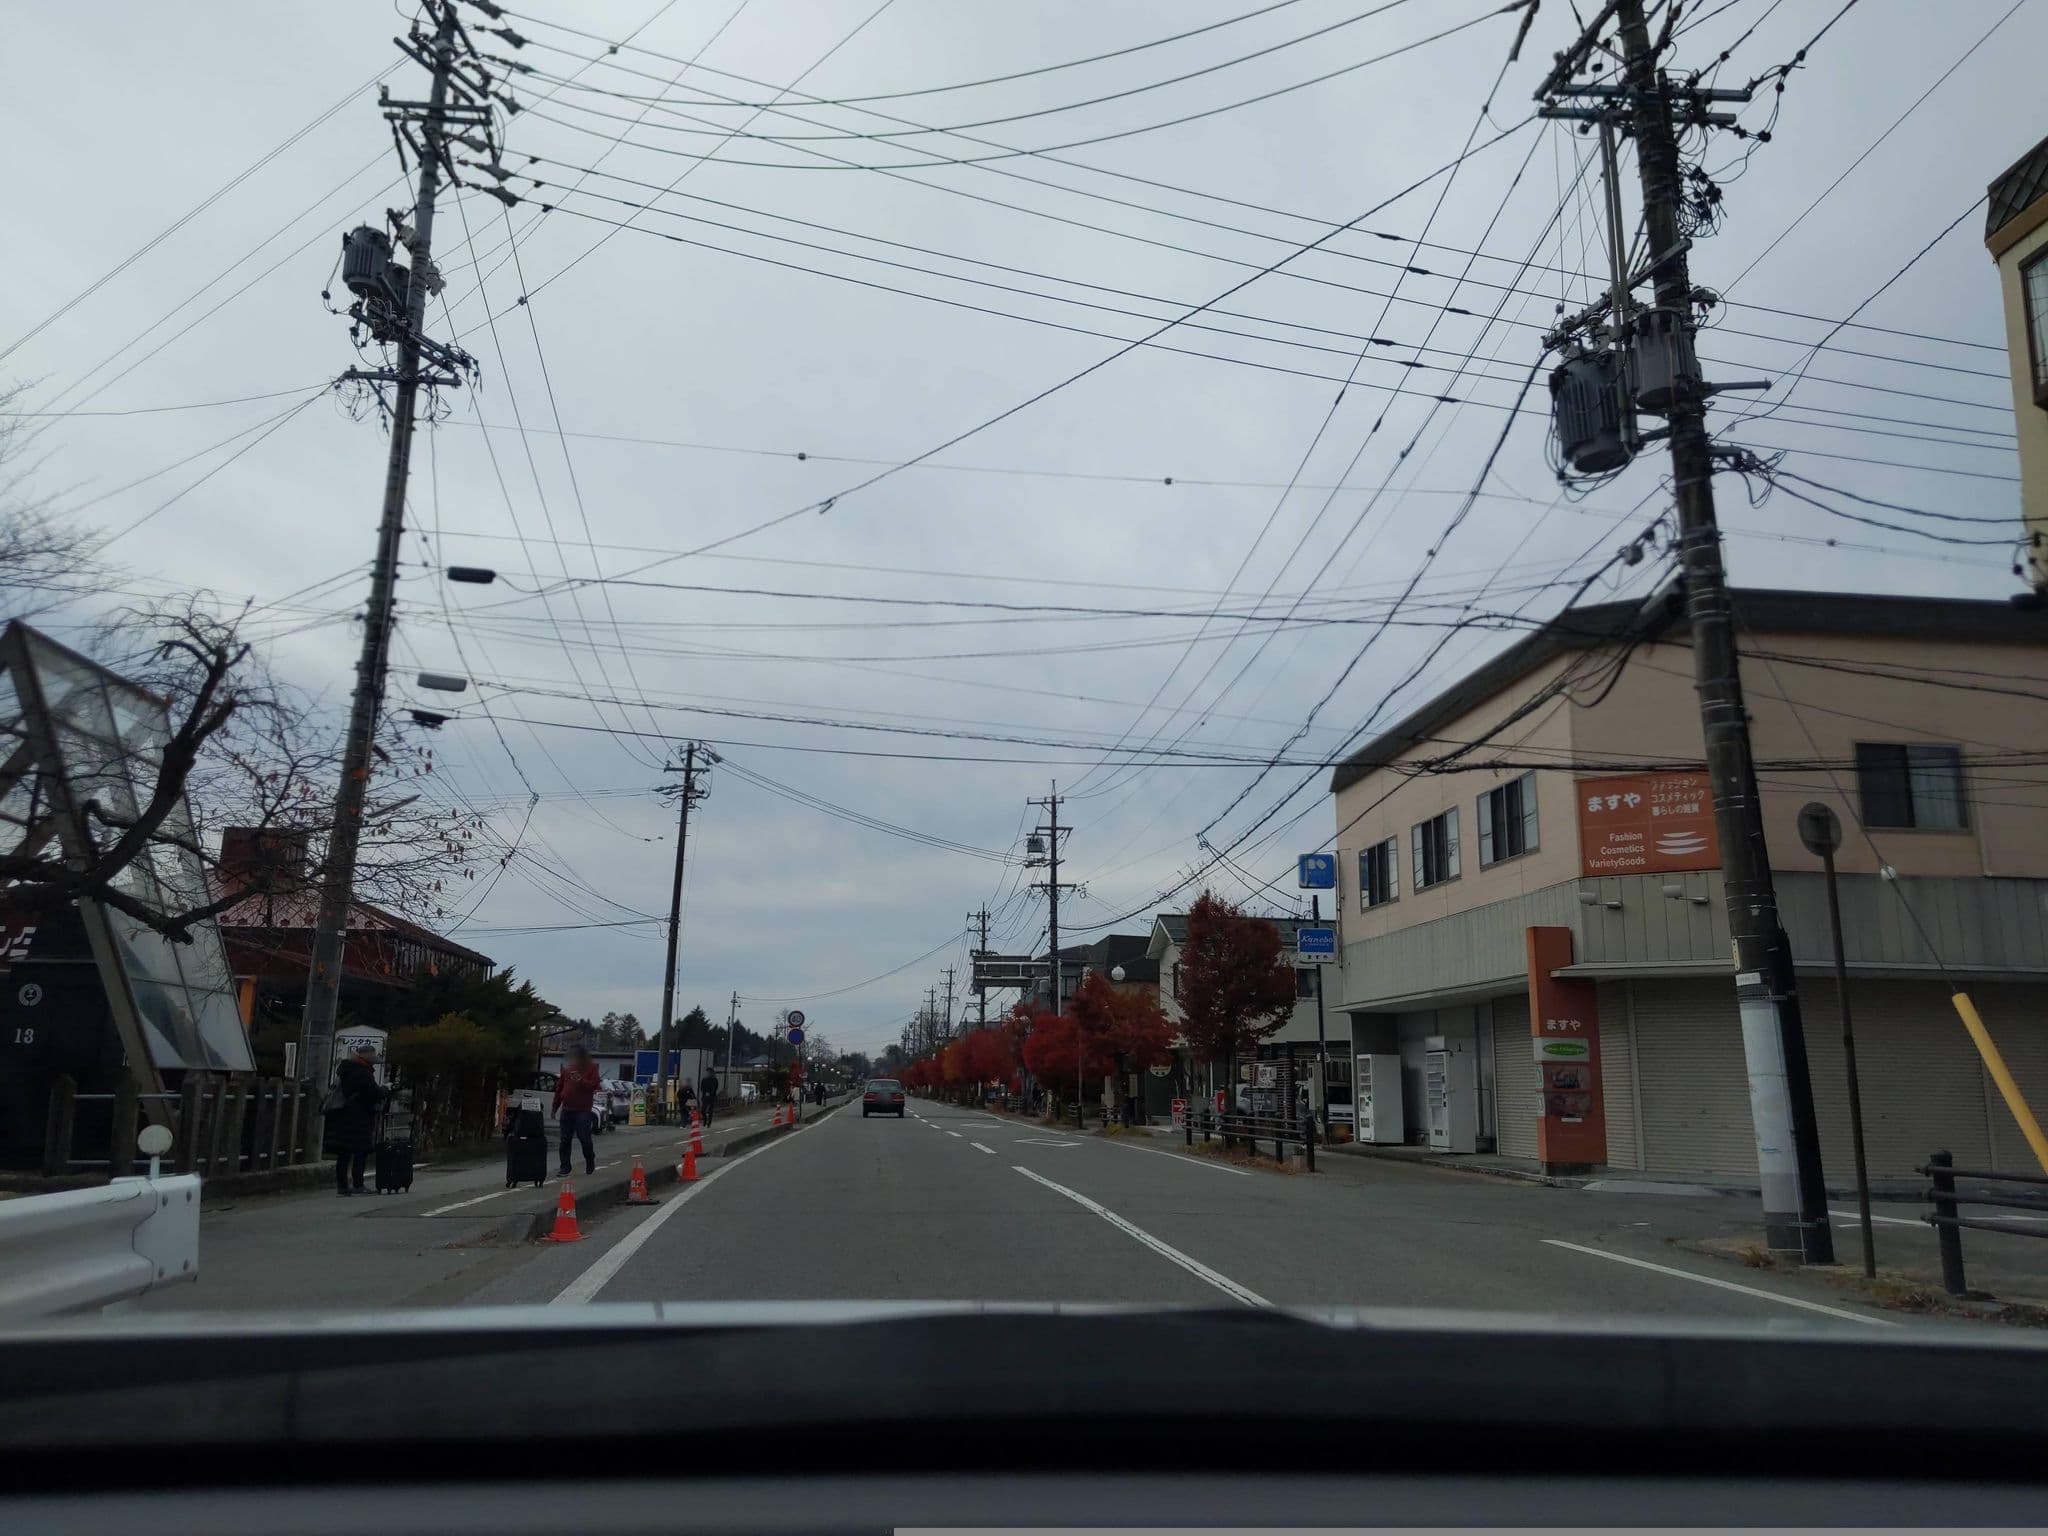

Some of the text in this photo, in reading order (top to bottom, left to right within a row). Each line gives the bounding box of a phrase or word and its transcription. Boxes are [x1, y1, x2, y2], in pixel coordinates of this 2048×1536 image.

[1587, 792, 1641, 812] ますや
[1609, 832, 1643, 842] Fashion
[1600, 844, 1645, 855] Cosmetics
[1589, 856, 1646, 869] VarietyGoods
[1301, 935, 1334, 943] Kanebo
[1546, 1019, 1581, 1031] ますや
[14, 1028, 34, 1044] 13
[342, 1038, 381, 1046] レンタカー
